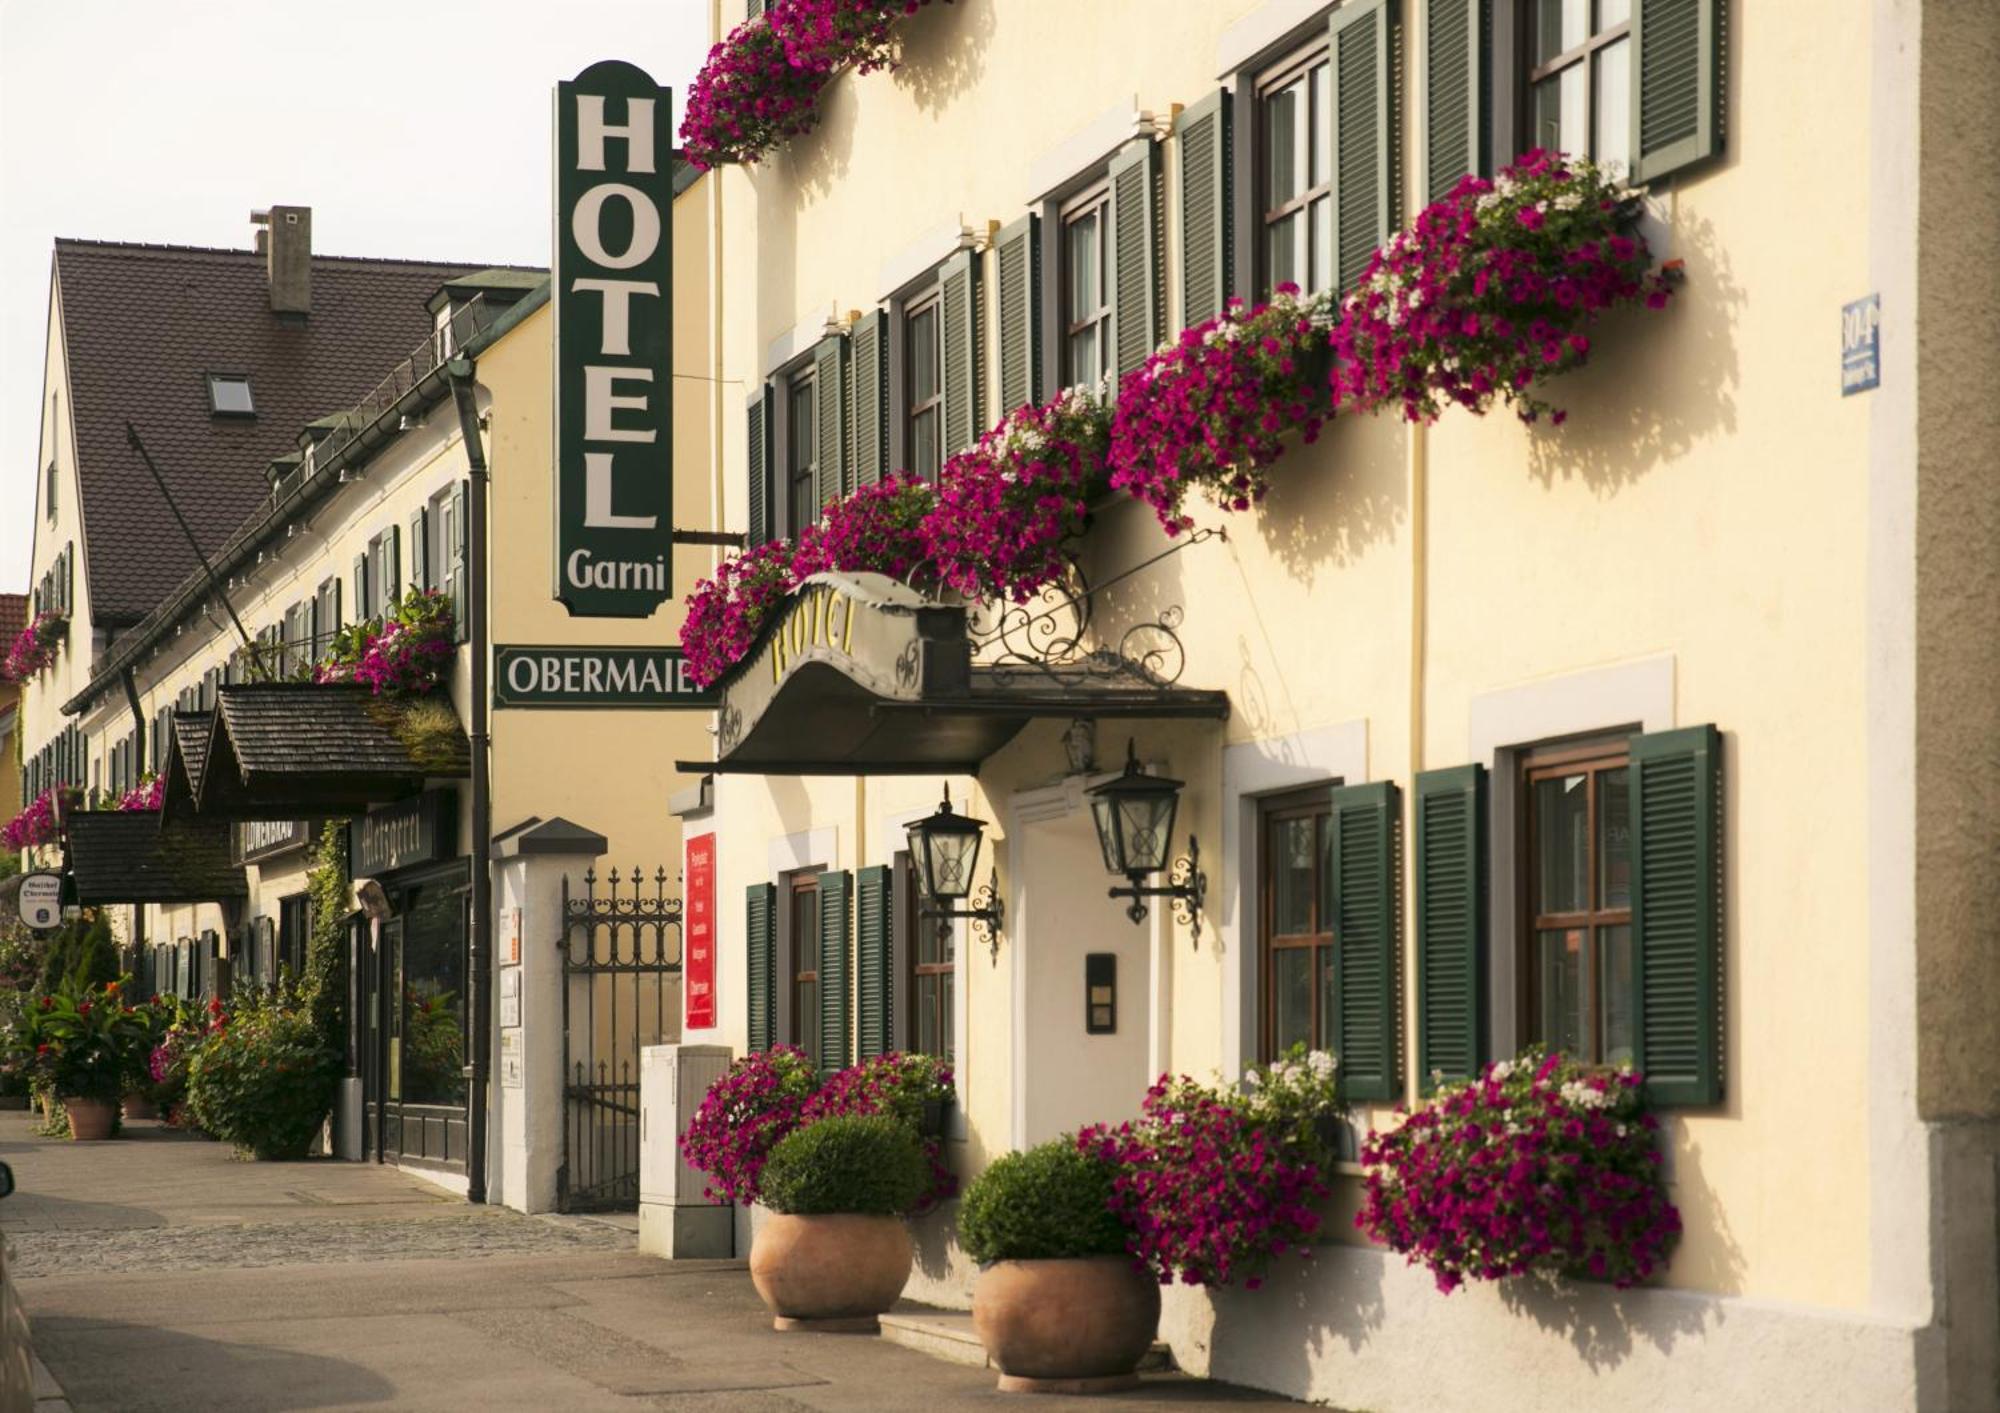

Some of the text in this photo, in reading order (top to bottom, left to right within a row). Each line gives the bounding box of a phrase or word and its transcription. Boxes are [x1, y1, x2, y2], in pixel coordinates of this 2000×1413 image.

[571, 94, 660, 529] HOTEL
[567, 548, 665, 592] Garni
[507, 656, 704, 693] OBERMAIE
